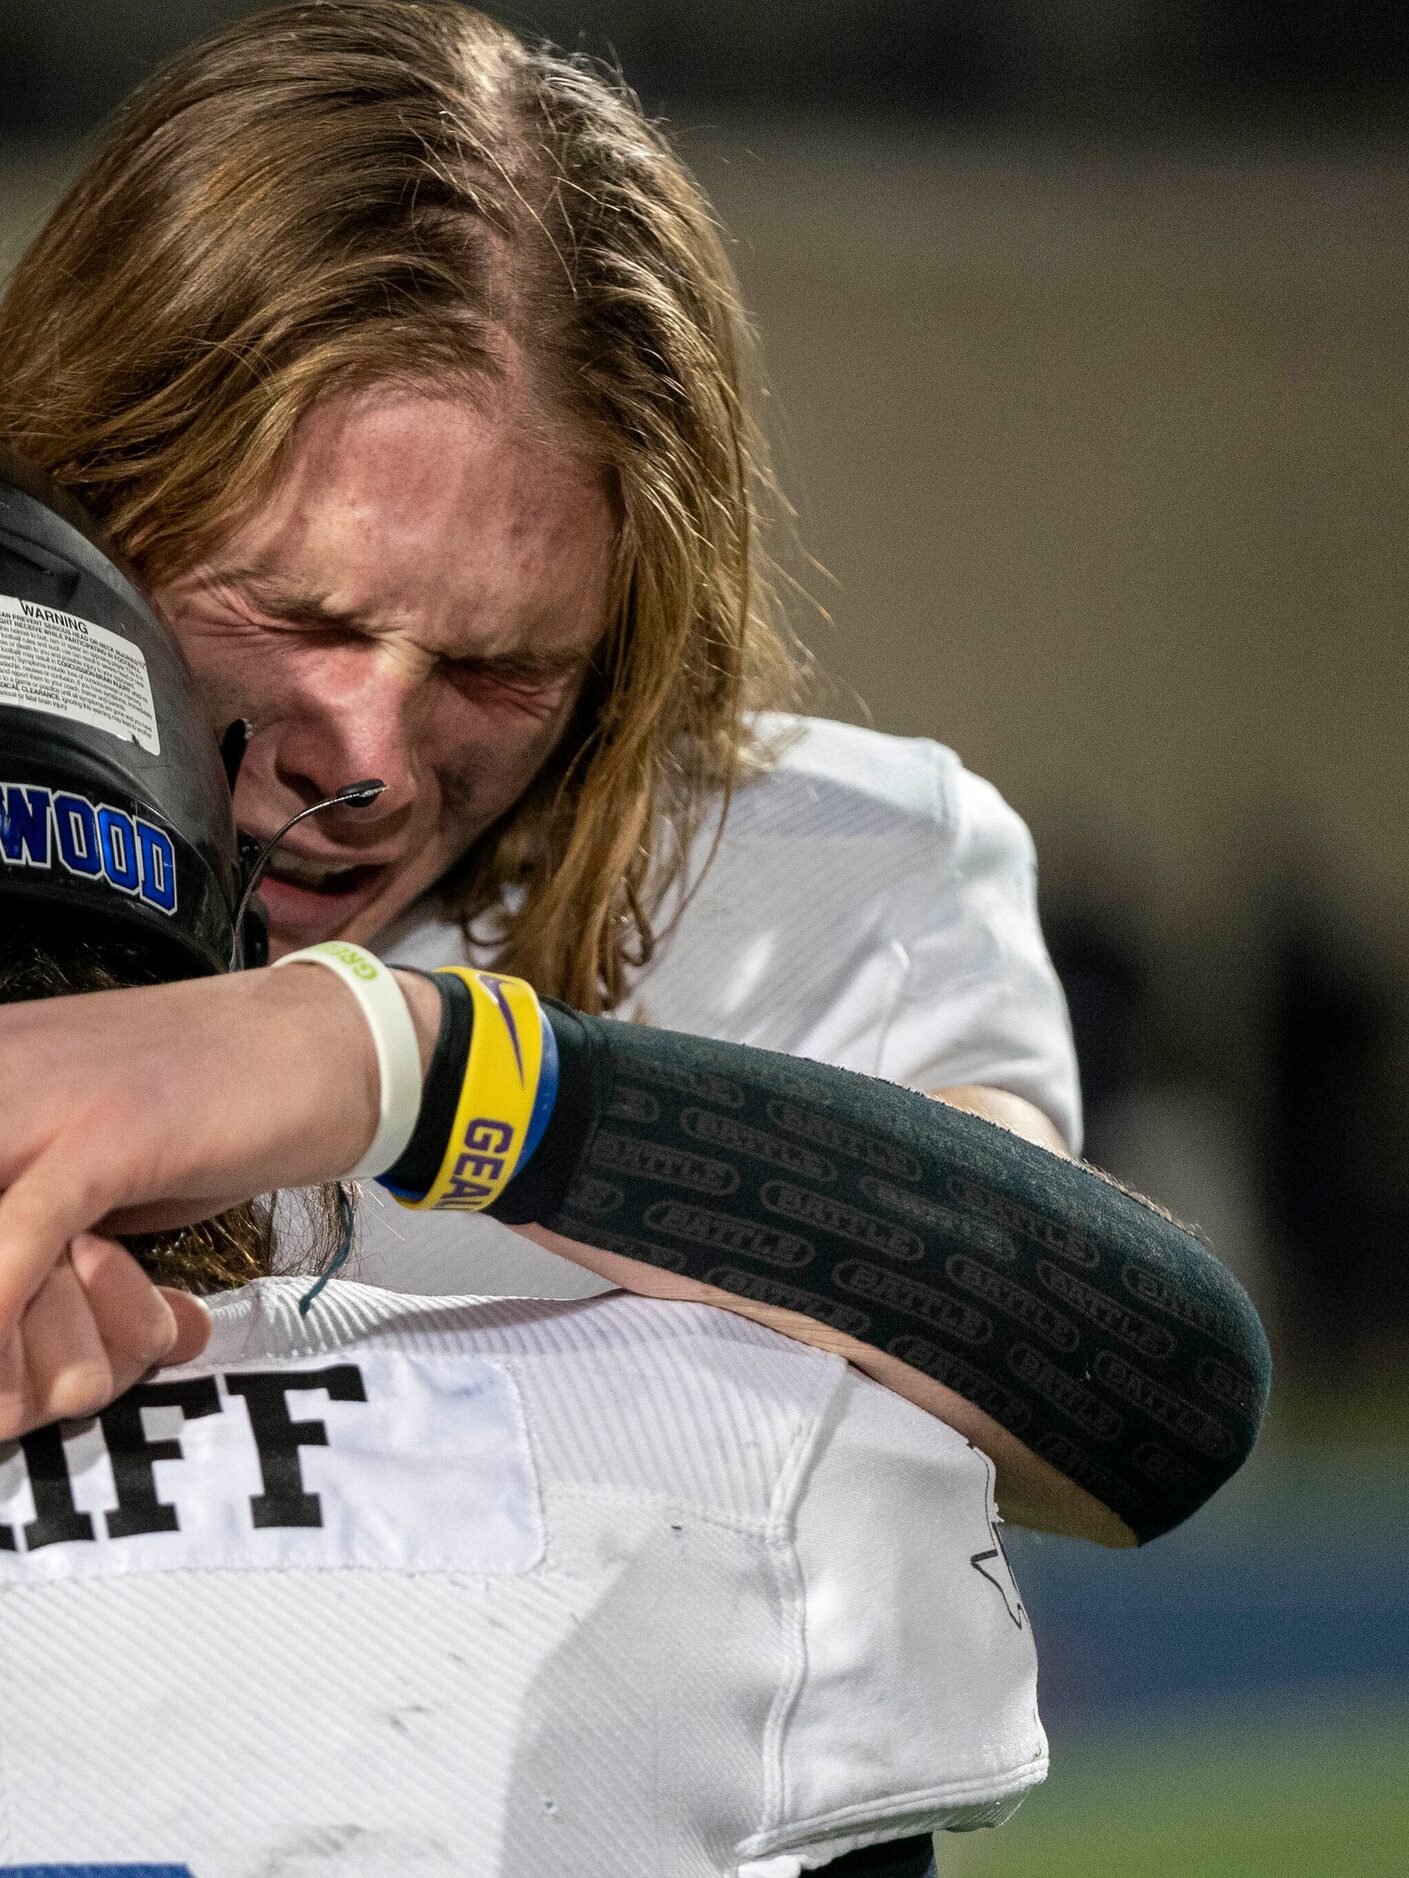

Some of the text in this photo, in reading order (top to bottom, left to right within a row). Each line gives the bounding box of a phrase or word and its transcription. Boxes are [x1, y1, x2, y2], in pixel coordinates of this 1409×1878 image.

[20, 601, 88, 635] WARNING
[660, 1204, 803, 1264] BATTLE
[776, 1186, 917, 1256] BATTLE
[848, 1262, 985, 1340] BATTLE
[959, 1259, 1074, 1347] BATTLE
[1045, 1269, 1168, 1356] BATTLE
